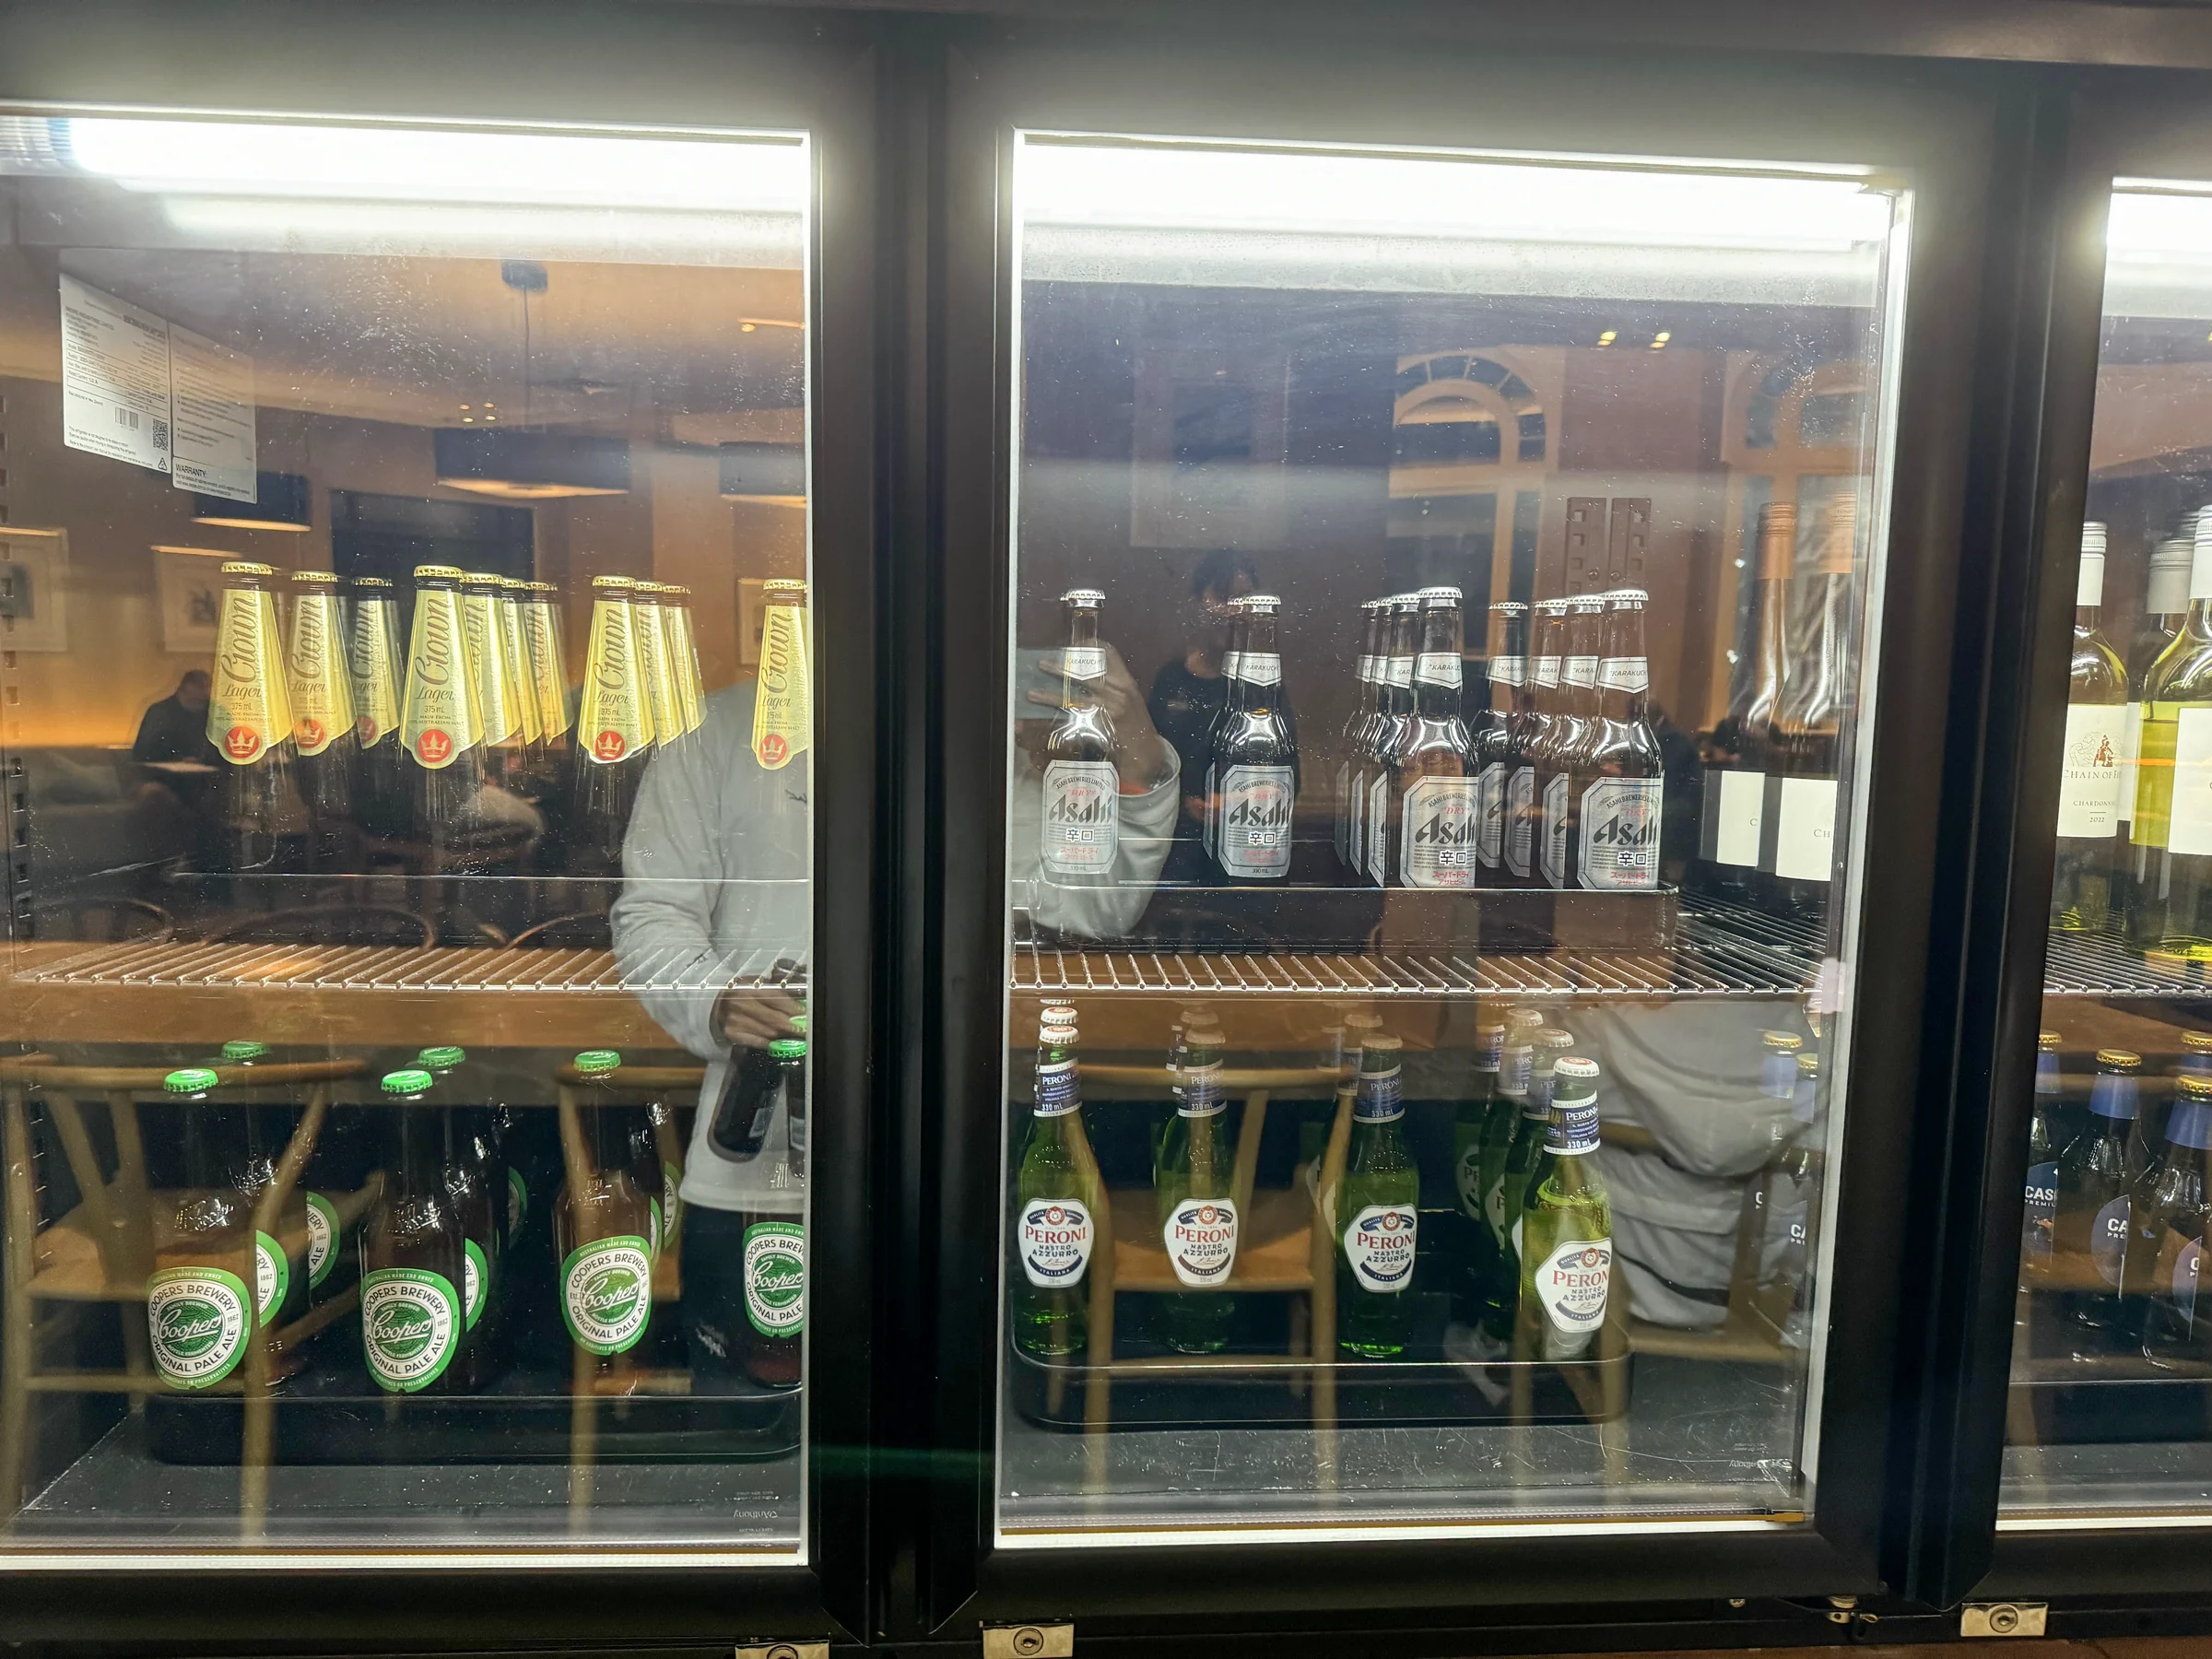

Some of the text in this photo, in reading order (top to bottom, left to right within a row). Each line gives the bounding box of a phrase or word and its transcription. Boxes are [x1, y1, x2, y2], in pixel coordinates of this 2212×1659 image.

[221, 593, 262, 684] Crown
[291, 600, 323, 679] Crown
[415, 598, 453, 686] Crown
[593, 608, 629, 690] Crown
[761, 613, 792, 693] Crown
[222, 683, 262, 700] Lager
[415, 686, 454, 703] Lager
[594, 690, 629, 707] Lager
[424, 705, 436, 713] 375
[1049, 794, 1112, 824] Asahi
[1229, 797, 1290, 827] Asahi
[1415, 812, 1476, 844] Asah
[1593, 814, 1658, 846] Asah
[1440, 850, 1466, 865] 辛口
[1618, 852, 1647, 865] 辛口
[1041, 1072, 1072, 1086] PERONI
[1041, 1103, 1053, 1112] 330
[1191, 1102, 1204, 1111] 330
[1567, 1137, 1592, 1149] 330 mL
[1025, 1224, 1088, 1244] PERONI
[1175, 1224, 1235, 1243] PERONI
[1357, 1230, 1416, 1250] PERONI
[579, 1244, 606, 1256] AUSTRALIAN
[746, 1239, 777, 1265] COOPERS
[1032, 1249, 1079, 1258] AZZURRO
[1182, 1247, 1229, 1257] AZZURRO
[1191, 1242, 1223, 1251] NASTRO
[311, 1246, 325, 1267] ALE
[760, 1254, 777, 1263] FAMILY
[1365, 1253, 1410, 1263] AZZURRO
[260, 1273, 274, 1282] 1862
[571, 1253, 647, 1288] COOPERS BREWERY
[1040, 1268, 1070, 1277] ITALIANA
[1191, 1267, 1221, 1276] ITALIANA
[1374, 1272, 1404, 1281] ITALIANA
[582, 1277, 641, 1311] Coopers
[1562, 1289, 1606, 1301] AZZURRO
[1571, 1286, 1602, 1294] NASTRO
[150, 1284, 237, 1317] COOPERS BREWERY
[364, 1286, 446, 1316] COOPERS BREWERY
[747, 1281, 803, 1322] ORIGINAL PALE
[571, 1295, 647, 1339] ORIGINAL PALE ALE
[1571, 1311, 1600, 1320] ITALIANA
[158, 1308, 223, 1342] Coopers
[372, 1310, 433, 1343] Coopers
[778, 1320, 805, 1334] PRESERVATI
[152, 1328, 237, 1372] ORIGINAL PALE ALE
[366, 1333, 446, 1374] ORIGINAL PALE ALE
